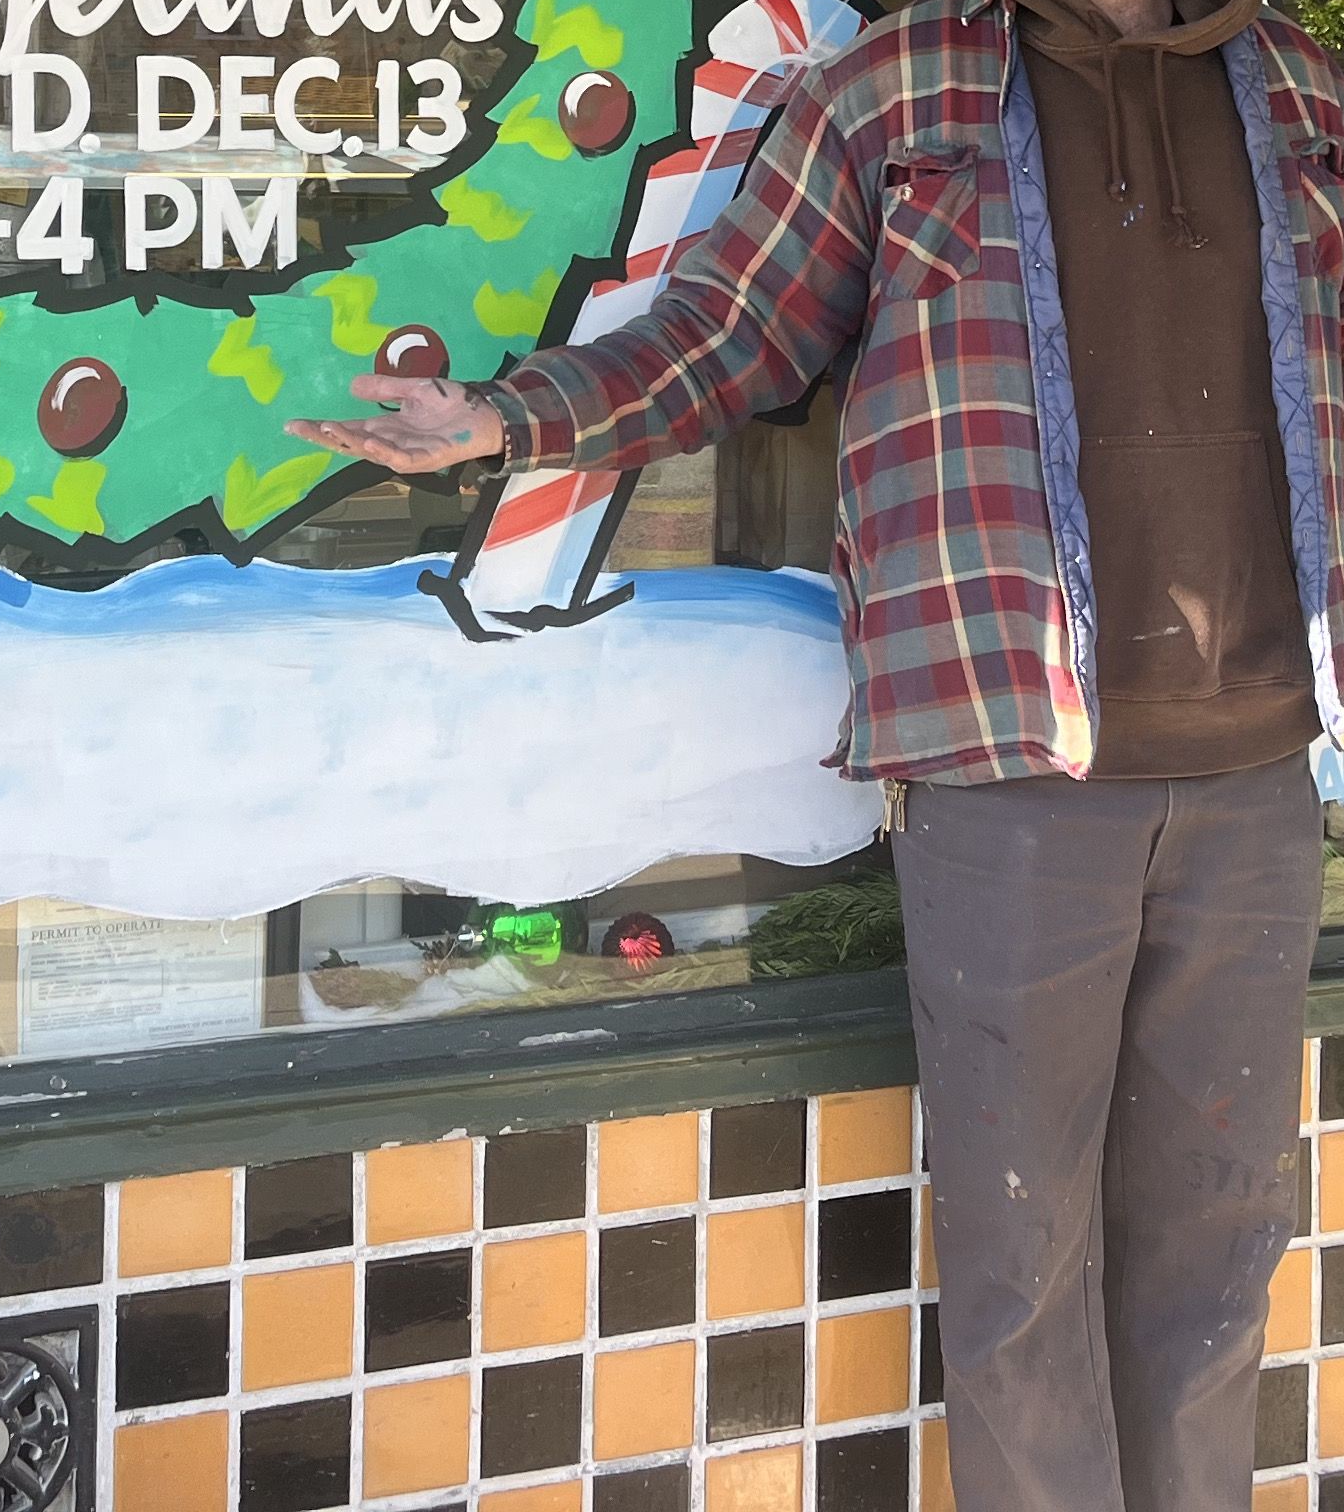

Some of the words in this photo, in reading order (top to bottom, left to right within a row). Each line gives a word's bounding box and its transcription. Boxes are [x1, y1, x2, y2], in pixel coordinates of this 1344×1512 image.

[124, 176, 298, 272] PM
[30, 927, 80, 941] PERMIT
[85, 924, 103, 936] TO
